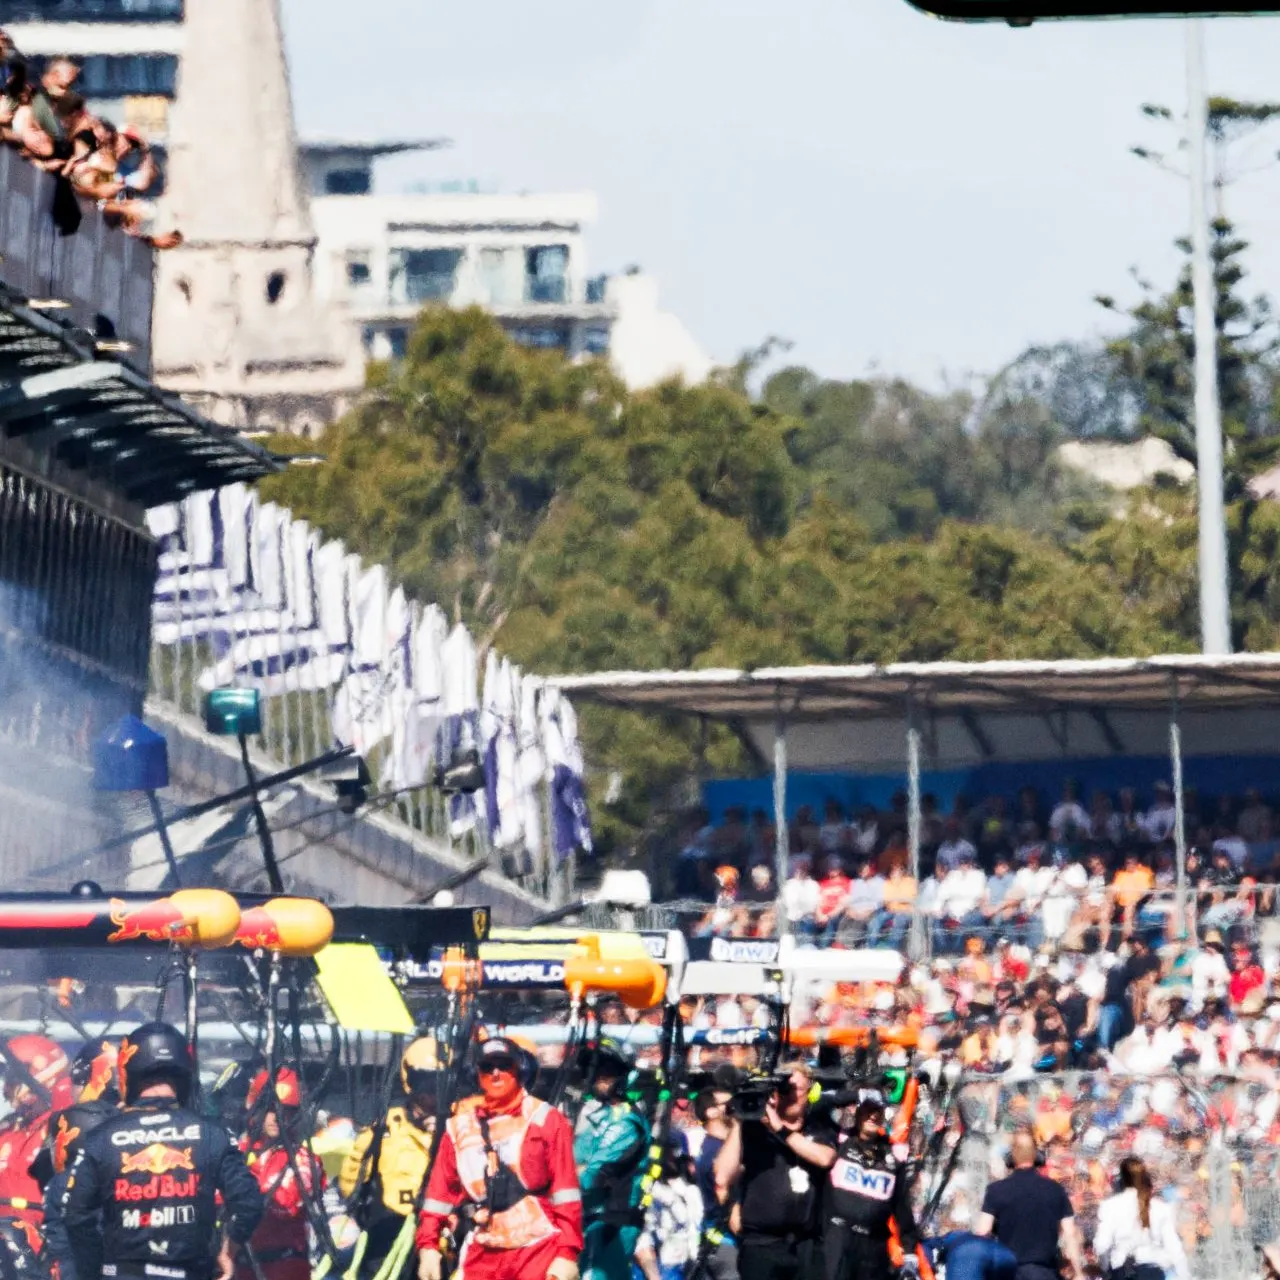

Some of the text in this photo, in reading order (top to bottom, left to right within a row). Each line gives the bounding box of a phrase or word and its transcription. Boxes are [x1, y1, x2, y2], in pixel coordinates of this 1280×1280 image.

[484, 962, 565, 984] WORLD
[706, 1027, 760, 1044] Gulf
[111, 1125, 201, 1147] ORACLE
[114, 1175, 159, 1202] Red
[844, 1165, 892, 1194] BWT
[122, 1205, 175, 1229] Mobil
